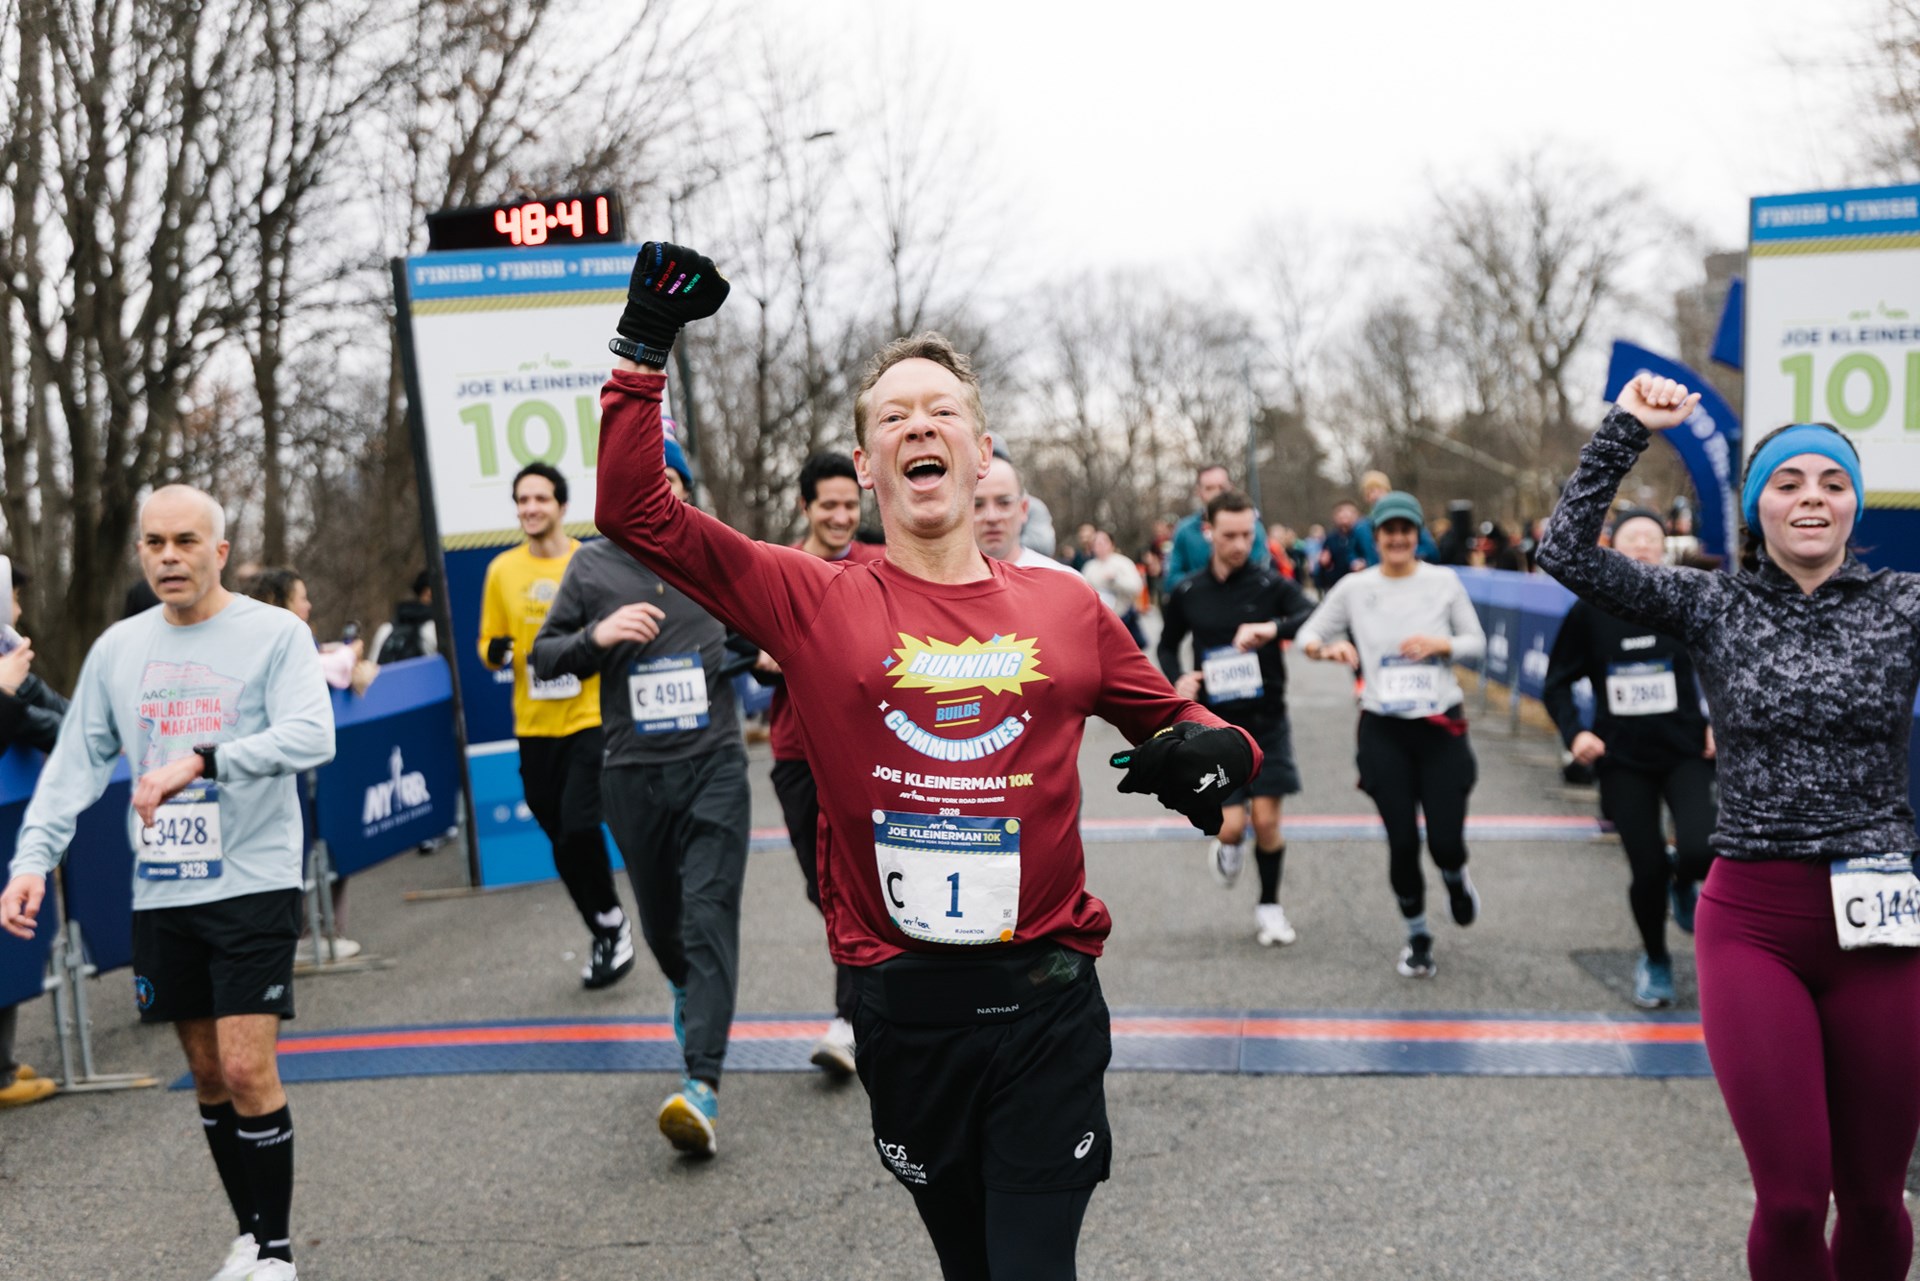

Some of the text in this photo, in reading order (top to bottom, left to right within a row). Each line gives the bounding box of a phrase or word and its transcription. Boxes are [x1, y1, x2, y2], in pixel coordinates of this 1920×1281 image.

[415, 256, 636, 285] FINISH FINISH FINIS
[682, 273, 701, 293] BRONX
[1780, 328, 1821, 347] JOE
[456, 373, 607, 398] JOE KLEINERM
[907, 650, 1024, 679] RUNNING
[637, 682, 695, 707] C 4911
[141, 698, 221, 718] PHILADELPHIA
[935, 702, 981, 722] BUILDS
[161, 716, 221, 736] MARATHON
[884, 709, 1025, 762] COMMUNITIES
[871, 765, 1034, 790] JOE KLEINERMAN 10K
[156, 817, 208, 846] 3428
[888, 826, 1001, 842] JOE KLEINERMAN 10K
[180, 861, 209, 878] 3428
[887, 871, 963, 918] C 1
[1846, 897, 1866, 928] C
[977, 1003, 1019, 1014] NATHAN
